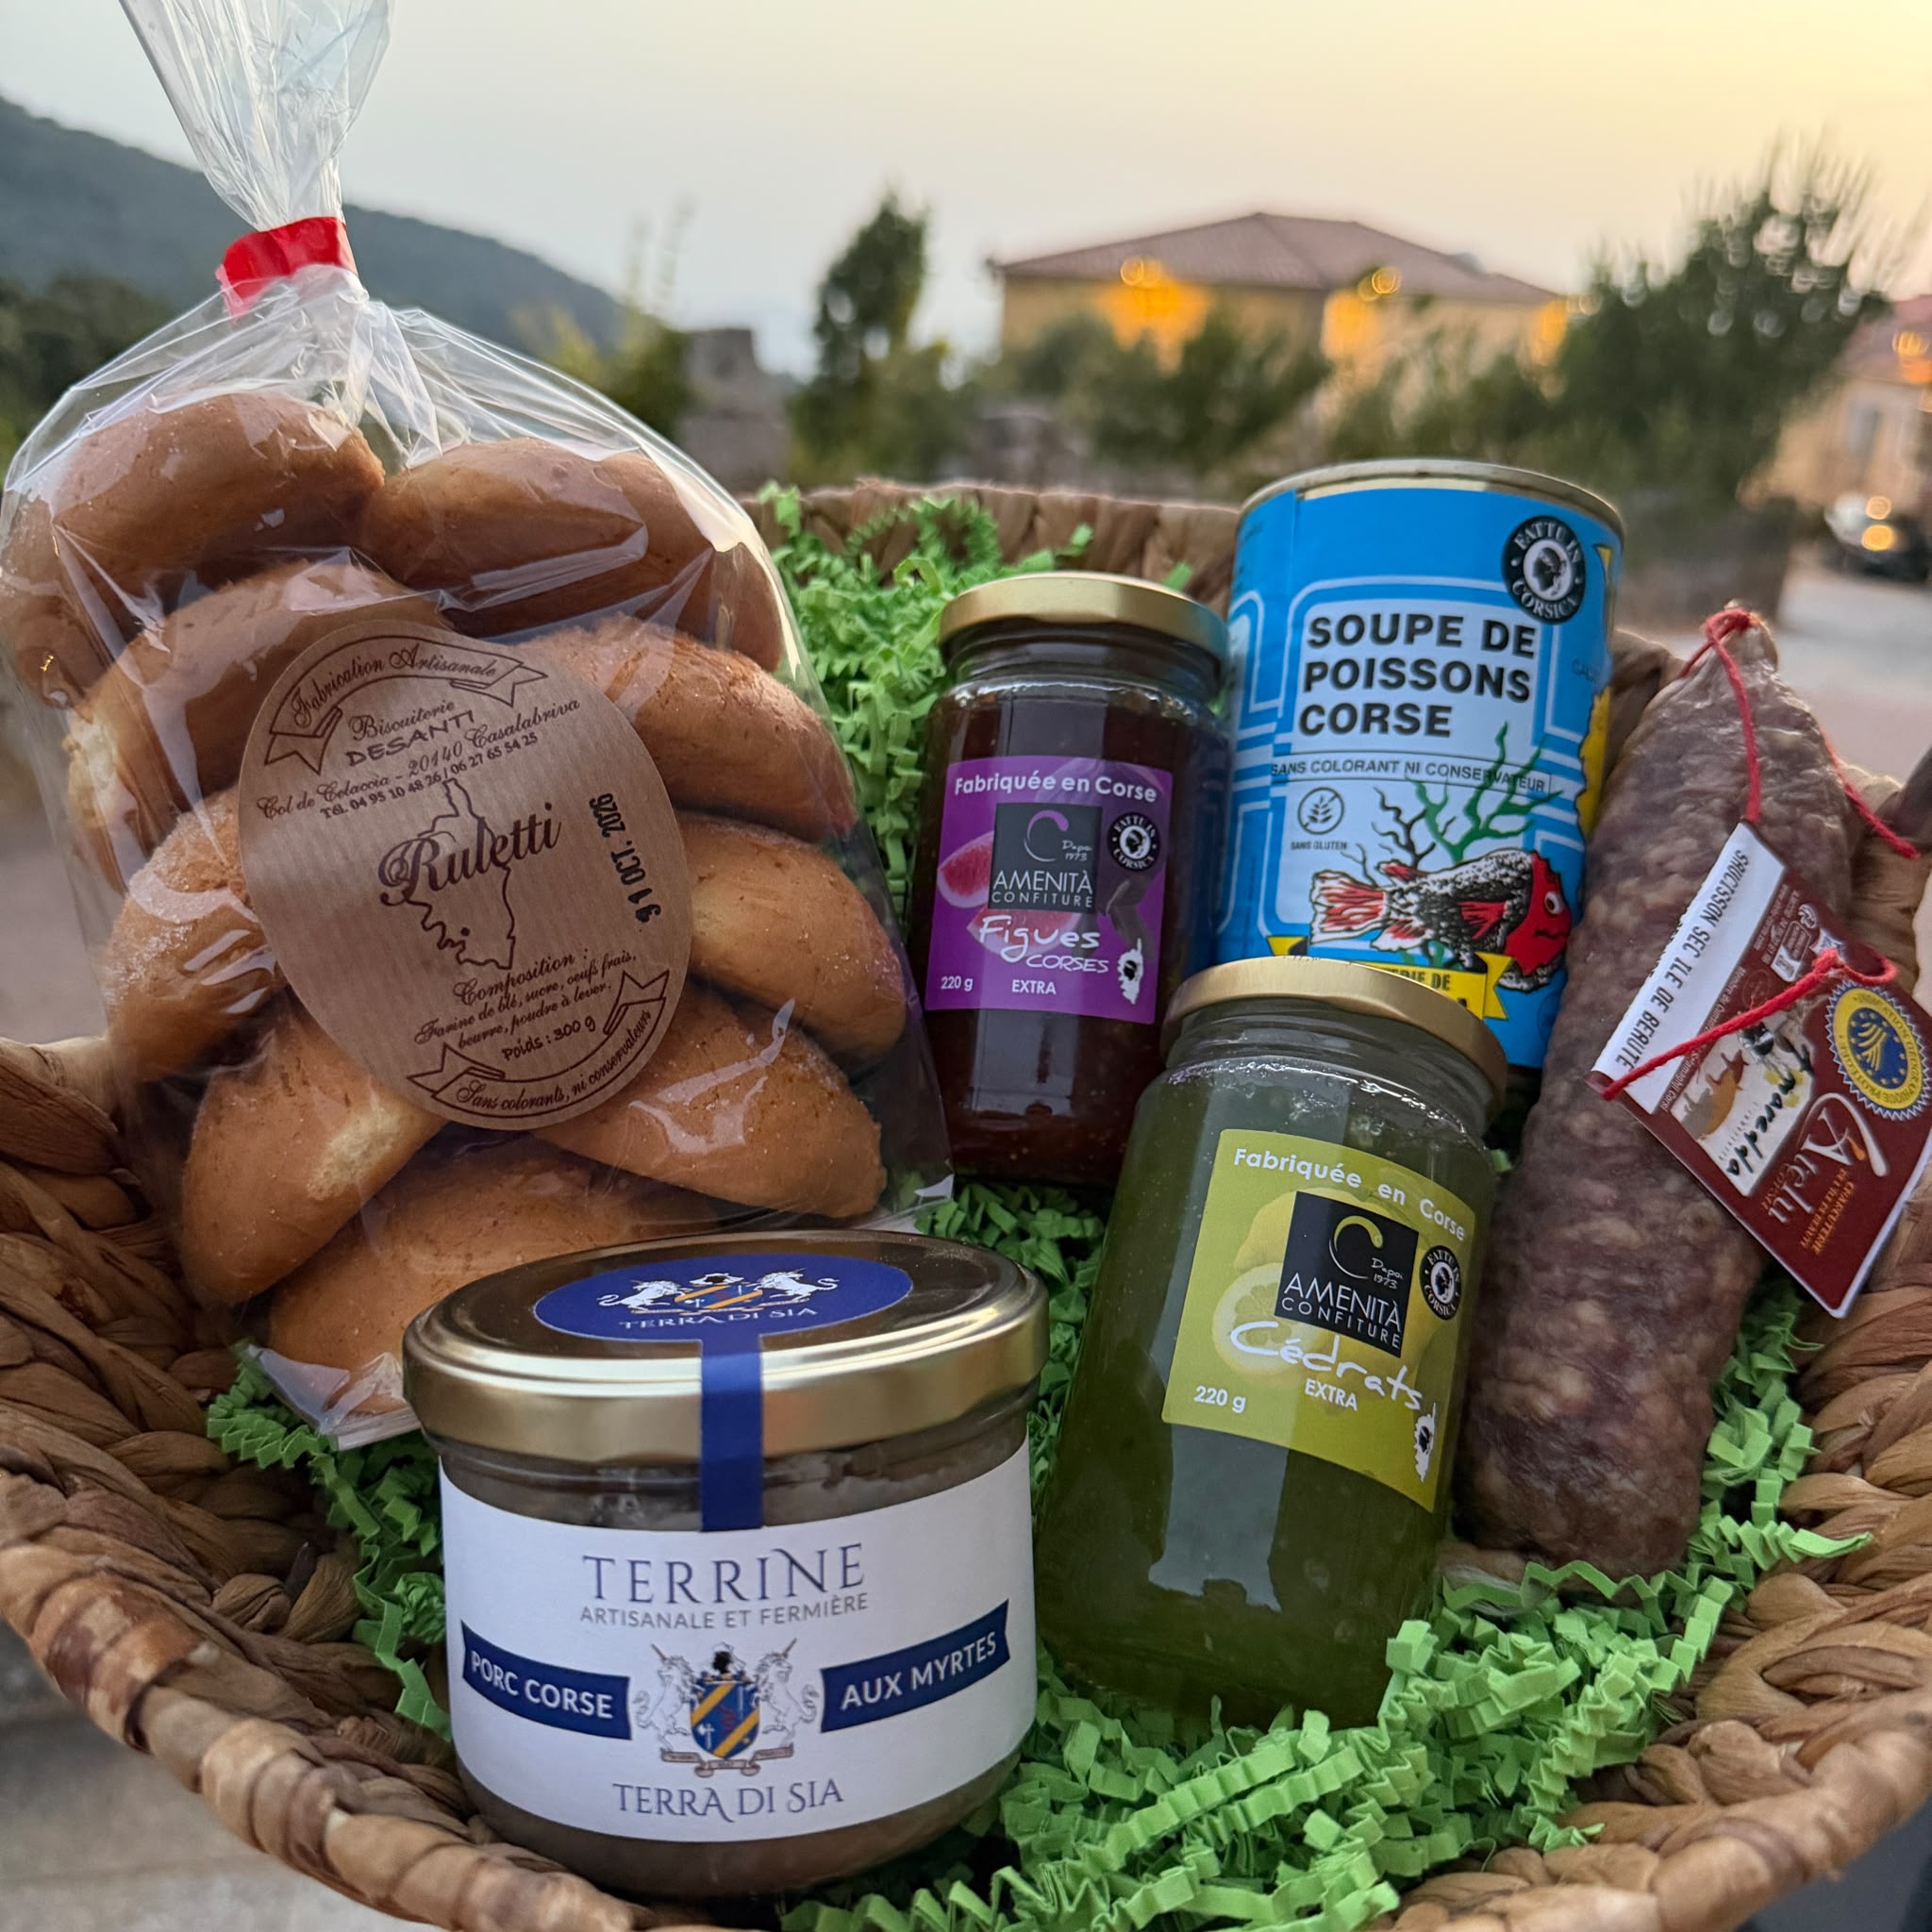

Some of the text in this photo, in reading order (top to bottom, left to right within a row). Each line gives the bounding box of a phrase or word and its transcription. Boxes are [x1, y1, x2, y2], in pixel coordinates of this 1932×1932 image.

[1514, 520, 1567, 549] FATTU
[1510, 583, 1578, 620] CORSICA
[1307, 612, 1537, 660] SOUPE DE
[291, 642, 498, 728] Fabrication Artisanale
[1303, 658, 1531, 704] POISSONS
[345, 710, 475, 767] DESANTI
[348, 699, 456, 741] Biscuiterie
[1298, 702, 1453, 739] CORSE
[257, 795, 292, 820] Col
[296, 791, 315, 810] de
[408, 741, 462, 777] 20140
[464, 699, 580, 748] Casalabriva
[351, 796, 367, 809] 04
[369, 792, 386, 805] 95
[389, 787, 406, 799] 10
[408, 779, 424, 793] 48
[426, 773, 441, 787] 26
[451, 762, 467, 775] 06
[471, 754, 484, 768] 27
[487, 747, 502, 760] 65
[506, 741, 521, 754] 54
[523, 732, 538, 746] 25
[1271, 758, 1545, 794] SANS COLORANT NI CONSERVATEUR
[955, 770, 1157, 803] Fabriquée en Corse
[589, 792, 625, 838] 2026
[377, 803, 563, 906] Ruletti
[1291, 841, 1348, 851] SANS GLUTEN
[991, 891, 1093, 908] CONFITURE
[992, 870, 1093, 894] AMENITÀ
[1700, 849, 1750, 927] SAUCISSON
[978, 914, 1100, 963] Figues
[1682, 924, 1711, 959] SEC
[453, 953, 575, 1006] Composition
[941, 975, 974, 991] 220 g
[1026, 953, 1109, 974] CORSES
[1431, 972, 1451, 991] DE
[1664, 957, 1692, 989] ILE
[414, 1014, 475, 1045] Farine
[478, 1003, 495, 1021] de
[525, 983, 564, 1003] sucre,
[601, 950, 637, 978] frais,
[1011, 979, 1057, 995] EXTRA
[1651, 986, 1674, 1013] DE
[1720, 993, 1730, 1007] du
[458, 1024, 508, 1050] beurre,
[511, 1001, 558, 1035] poudre
[561, 994, 571, 1008] à
[501, 1039, 543, 1061] Poids
[554, 1021, 581, 1041] 300
[585, 1016, 596, 1032] g
[457, 1010, 651, 1111] Sans colorants, ni conservateurs
[1659, 1090, 1675, 1111] Corsi
[1233, 1147, 1466, 1241] Fabriquée en Corse
[1809, 1180, 1857, 1256] CHARCUTERIE
[1284, 1272, 1402, 1333] AMENITÀ
[1373, 1273, 1398, 1290] 1973
[620, 1307, 818, 1330] TERRA DI SIA
[1281, 1296, 1401, 1348] CONFITURE
[1230, 1321, 1424, 1411] Cédrats
[1193, 1385, 1246, 1414] 220 g
[1304, 1377, 1358, 1412] EXTRA
[581, 1542, 866, 1605] TERRINE
[580, 1592, 869, 1630] ARTISANALE ET FERMIÈRE
[471, 1647, 614, 1720] PORC CORSE
[840, 1631, 997, 1710] AUX MYRTES
[612, 1777, 844, 1824] TERRA DI SIA
